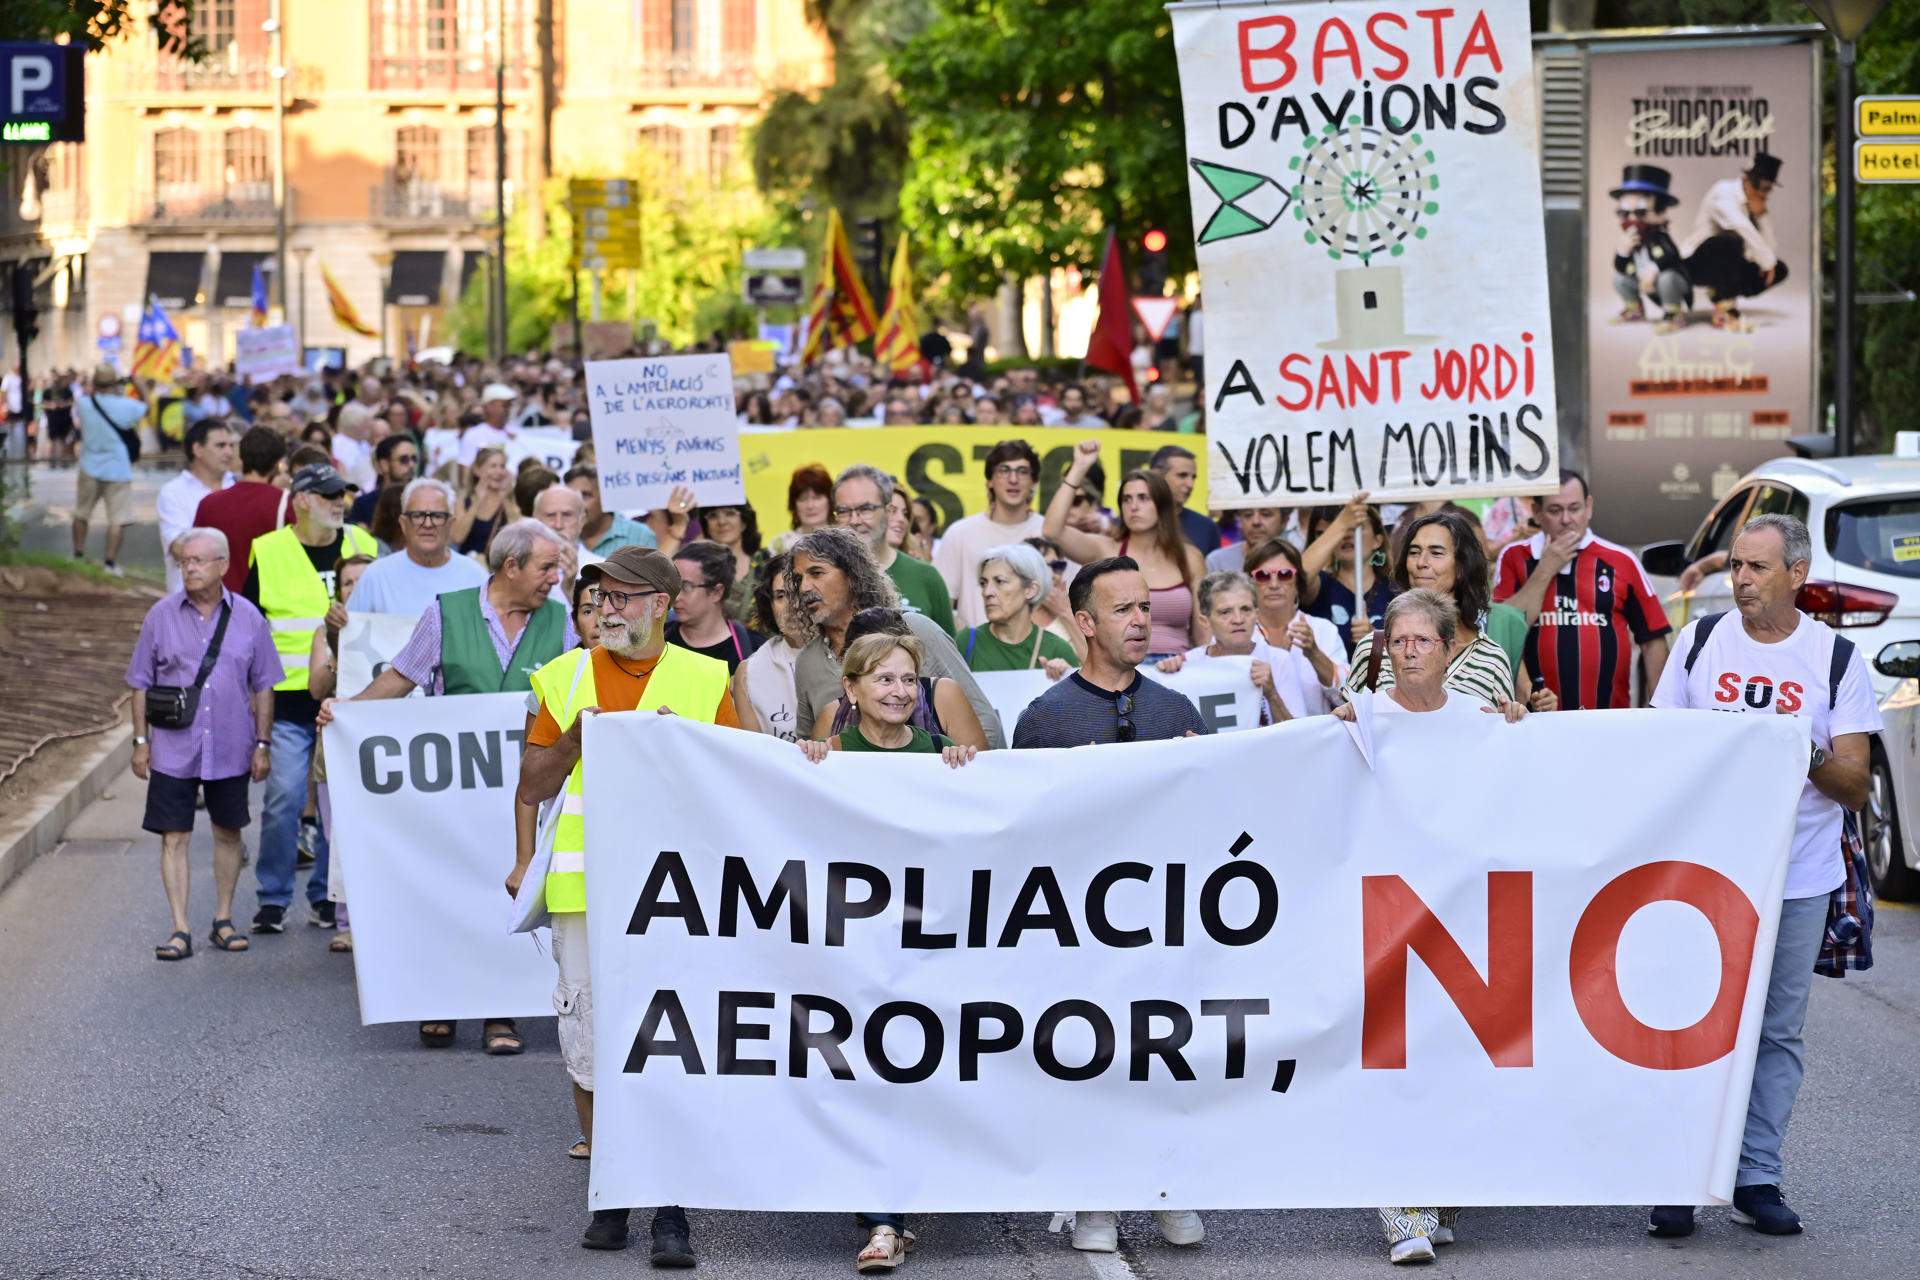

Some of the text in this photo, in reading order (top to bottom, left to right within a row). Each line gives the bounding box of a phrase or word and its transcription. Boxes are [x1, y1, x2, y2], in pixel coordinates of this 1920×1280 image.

[1238, 8, 1503, 93] BASTA
[11, 55, 53, 114] P
[1868, 110, 1920, 126] Palm
[595, 384, 607, 398] A
[643, 364, 668, 378] NO
[1214, 360, 1265, 412] A
[1276, 350, 1411, 412] SANT
[604, 400, 624, 415] DE
[1216, 427, 1363, 496] VOLEM
[1533, 609, 1608, 627] mirates
[1554, 595, 1578, 611] Fly
[1714, 672, 1804, 712] SOS
[625, 831, 1280, 950] AMPLIACIÓ
[1362, 860, 1761, 1070] NO
[622, 989, 1298, 1095] AEROPORT,
